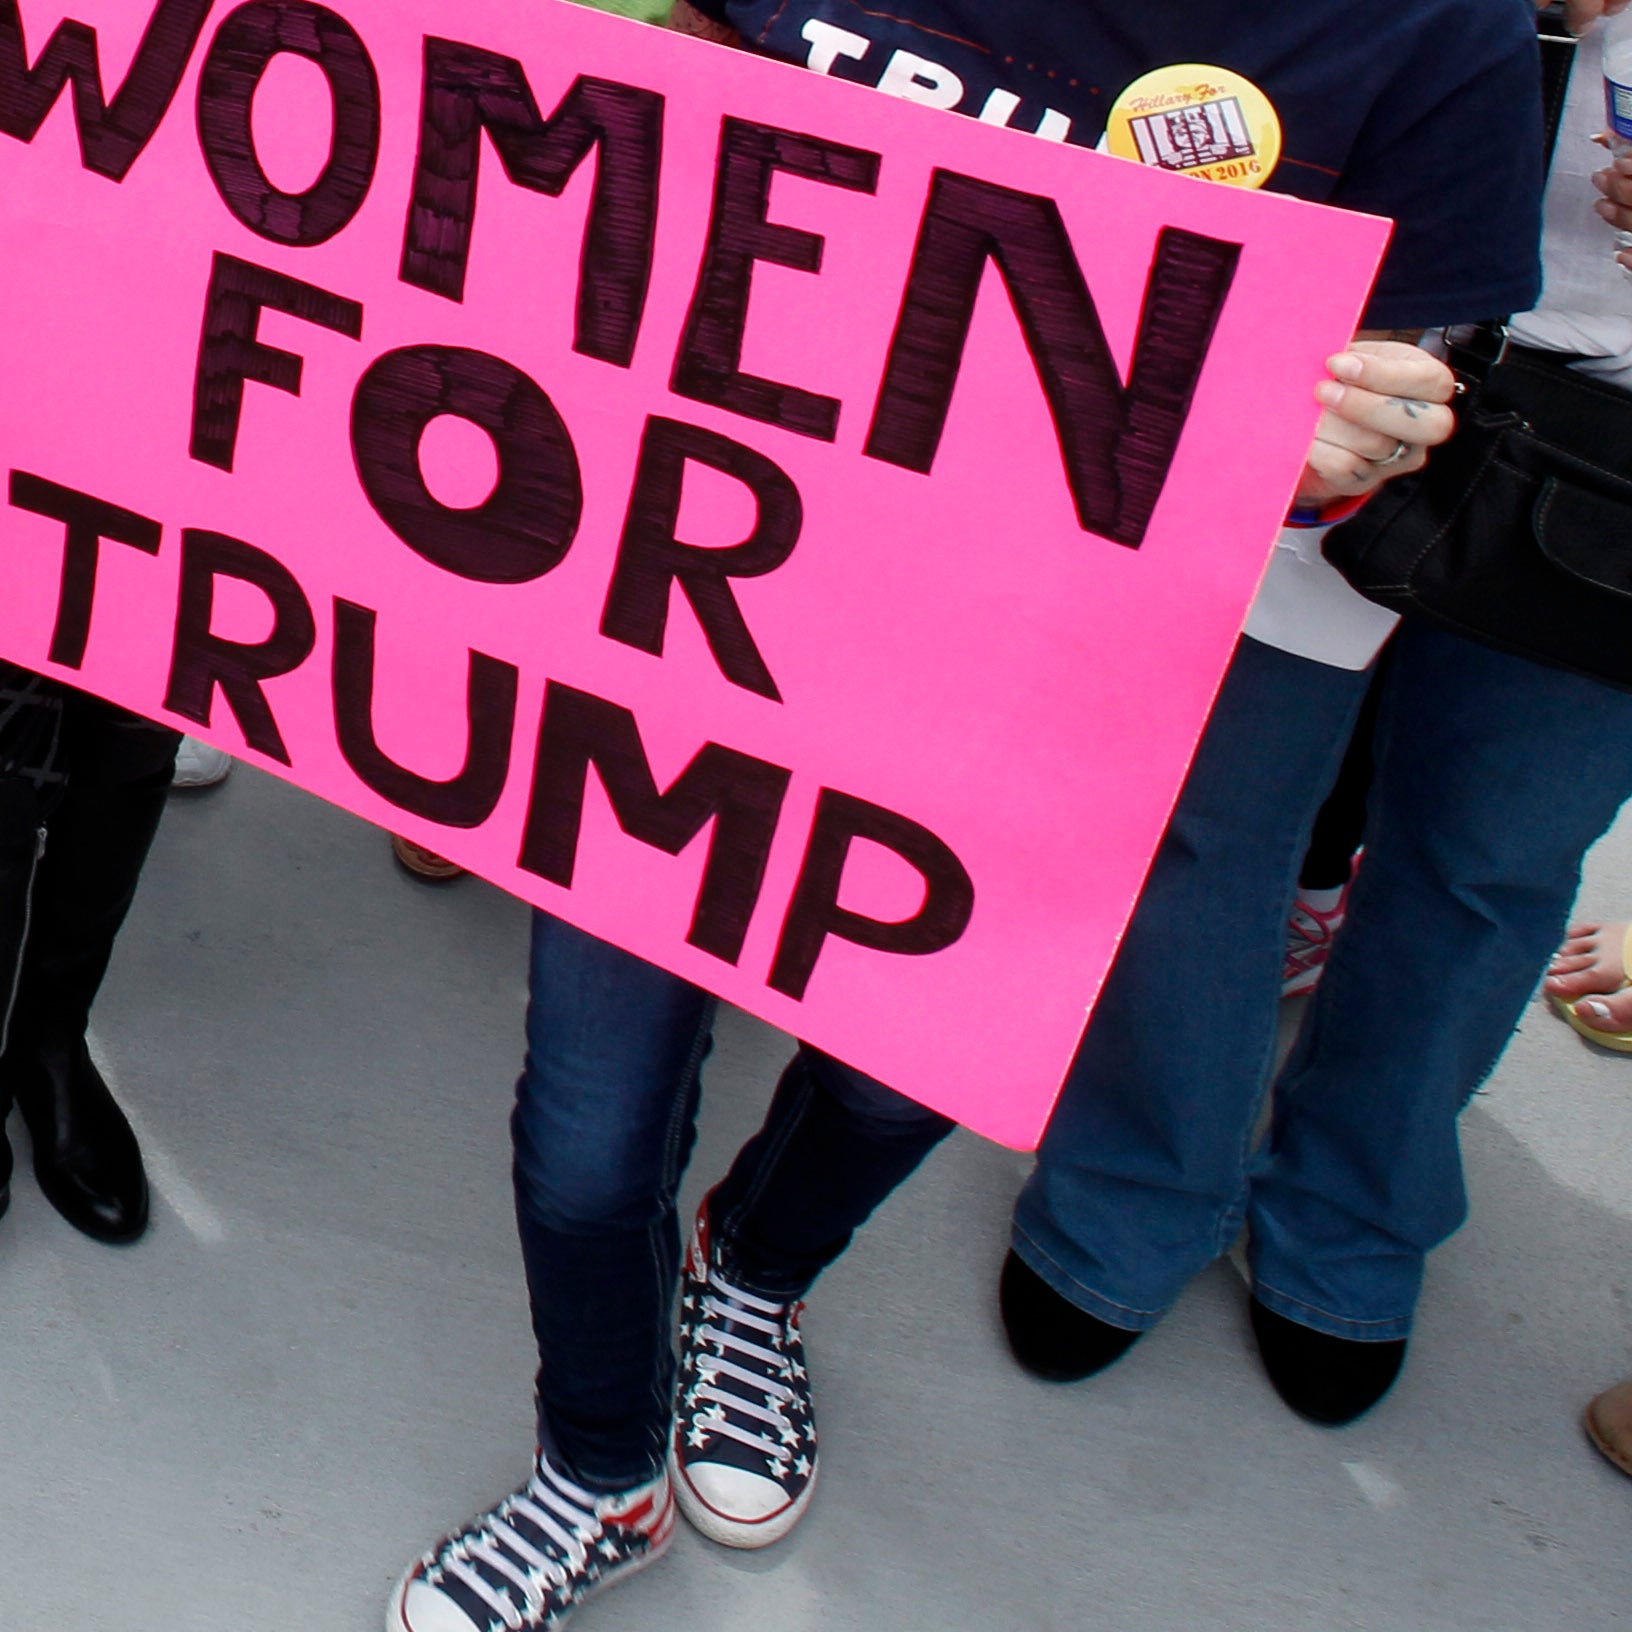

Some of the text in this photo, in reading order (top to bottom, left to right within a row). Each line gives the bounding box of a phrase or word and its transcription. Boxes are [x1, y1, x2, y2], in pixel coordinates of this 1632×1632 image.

[1129, 84, 1227, 113] Hillary For
[1216, 159, 1262, 181] 2016
[187, 251, 804, 703] FOR
[6, 469, 977, 1002] TRUMP
